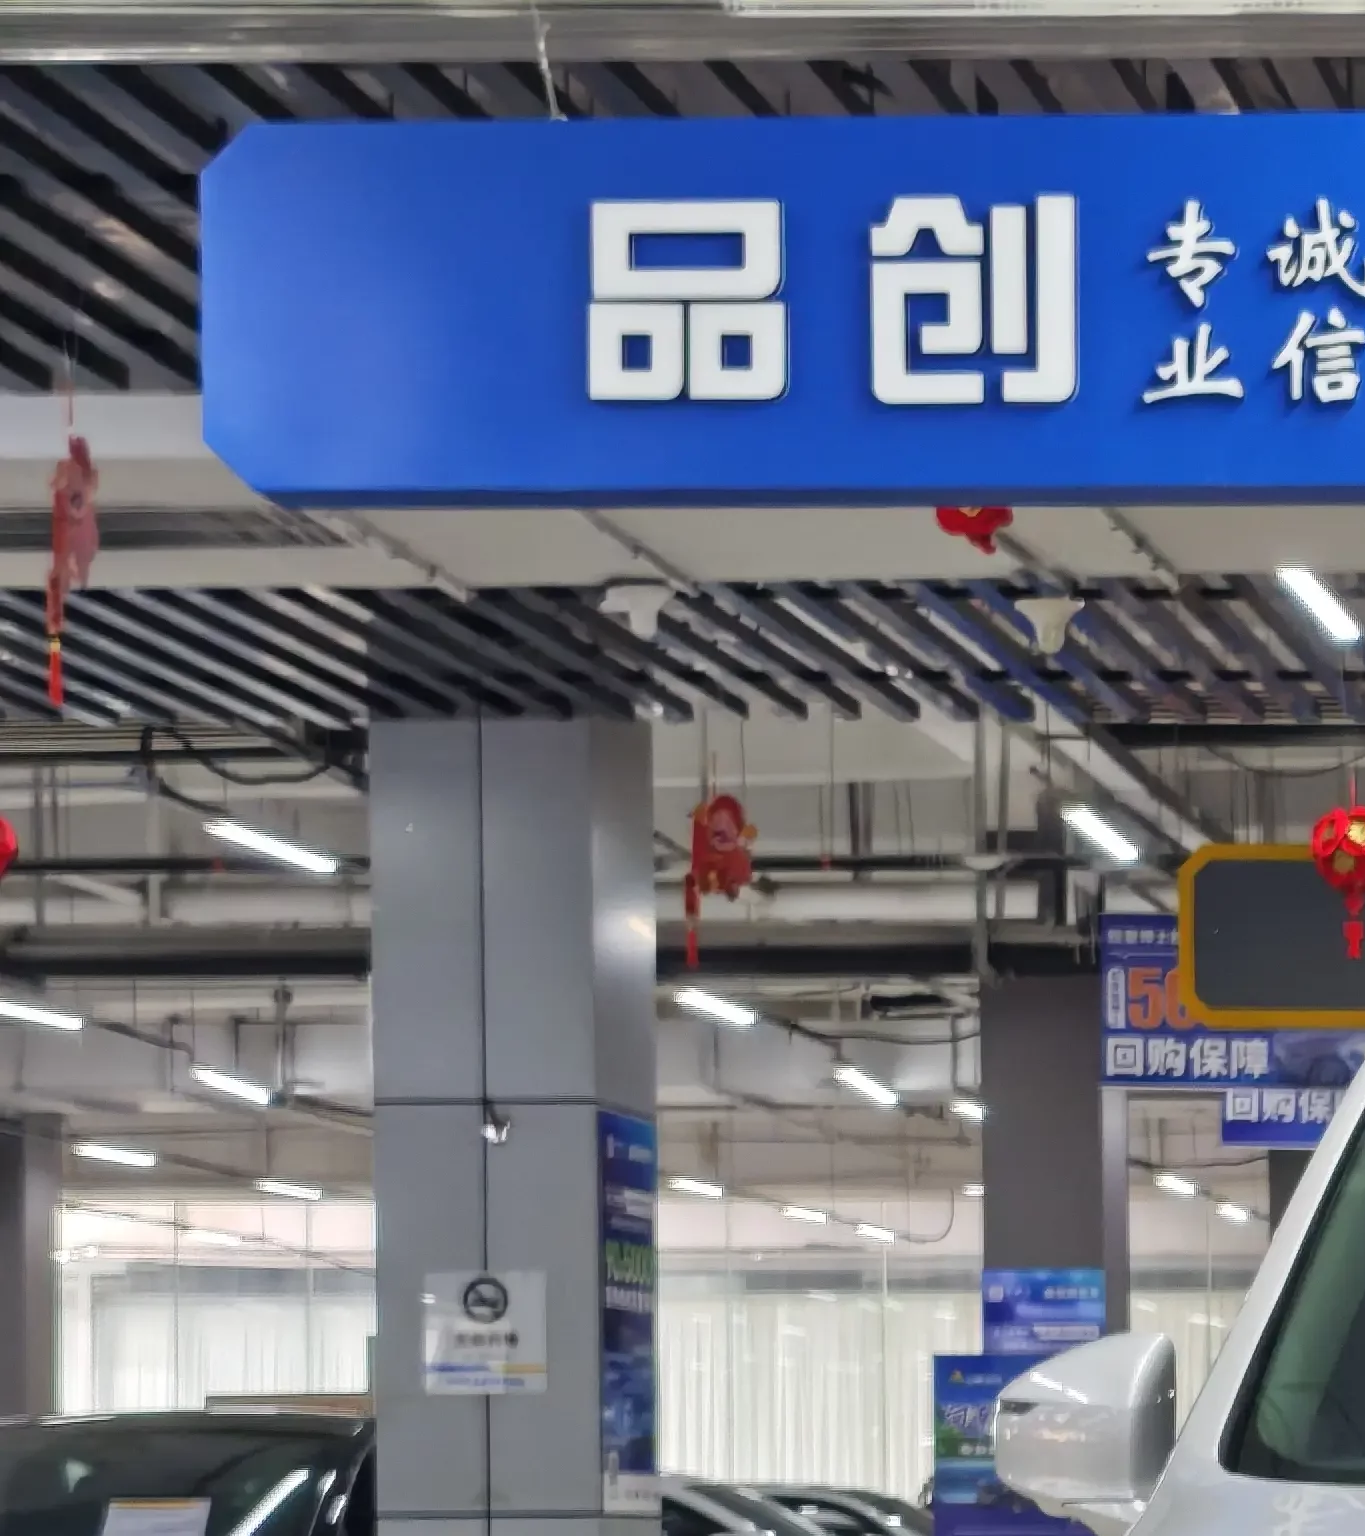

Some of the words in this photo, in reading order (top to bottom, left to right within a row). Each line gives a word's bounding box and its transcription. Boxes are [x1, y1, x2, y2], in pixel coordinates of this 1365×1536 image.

[589, 196, 1077, 404] 品创
[1106, 1036, 1270, 1079] 回购保障
[1226, 1087, 1347, 1124] 回购保
